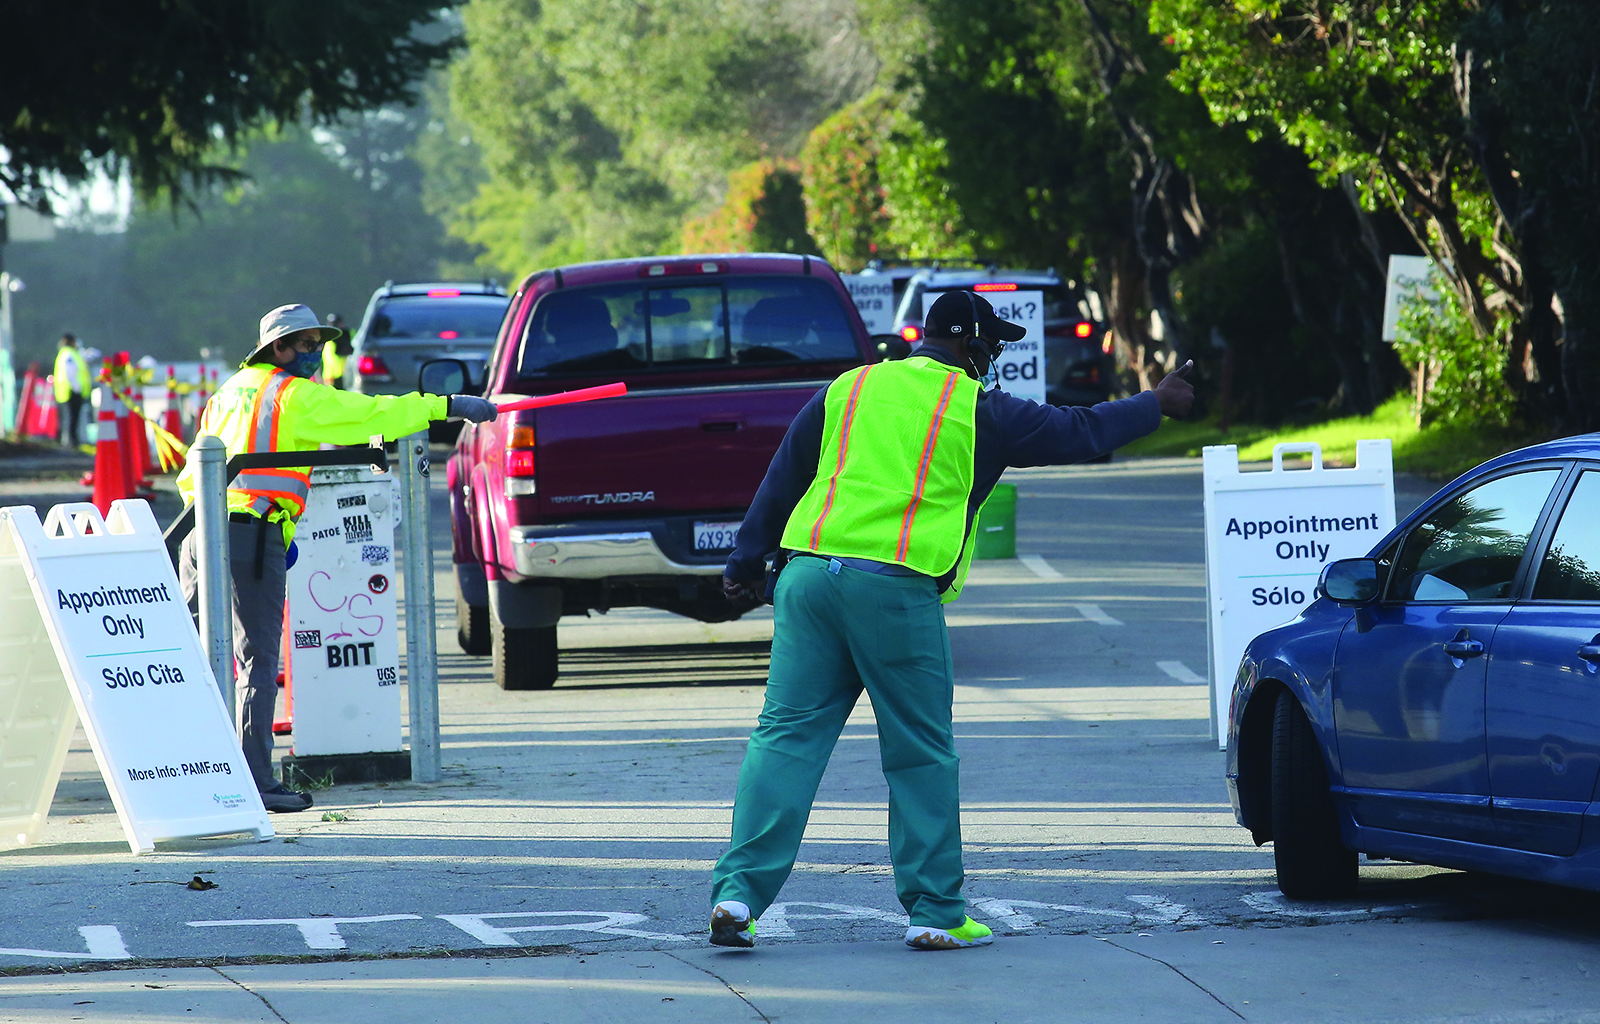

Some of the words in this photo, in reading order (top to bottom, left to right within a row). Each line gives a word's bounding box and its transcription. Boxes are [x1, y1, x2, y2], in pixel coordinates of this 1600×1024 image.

[580, 491, 655, 505] TUNDRA
[343, 514, 371, 531] KILL
[345, 523, 372, 533] YOUR
[1225, 512, 1379, 540] Appointment
[312, 527, 341, 541] PATOE
[1275, 541, 1330, 563] Only
[58, 582, 171, 614] Appointment
[1252, 586, 1305, 606] Sólo
[102, 614, 144, 639] Only
[102, 665, 145, 690] Sólo
[147, 663, 185, 687] Cita
[377, 667, 396, 681] UGS
[128, 768, 155, 782] More
[155, 765, 181, 780] Info:
[181, 761, 232, 778] PAMF.org
